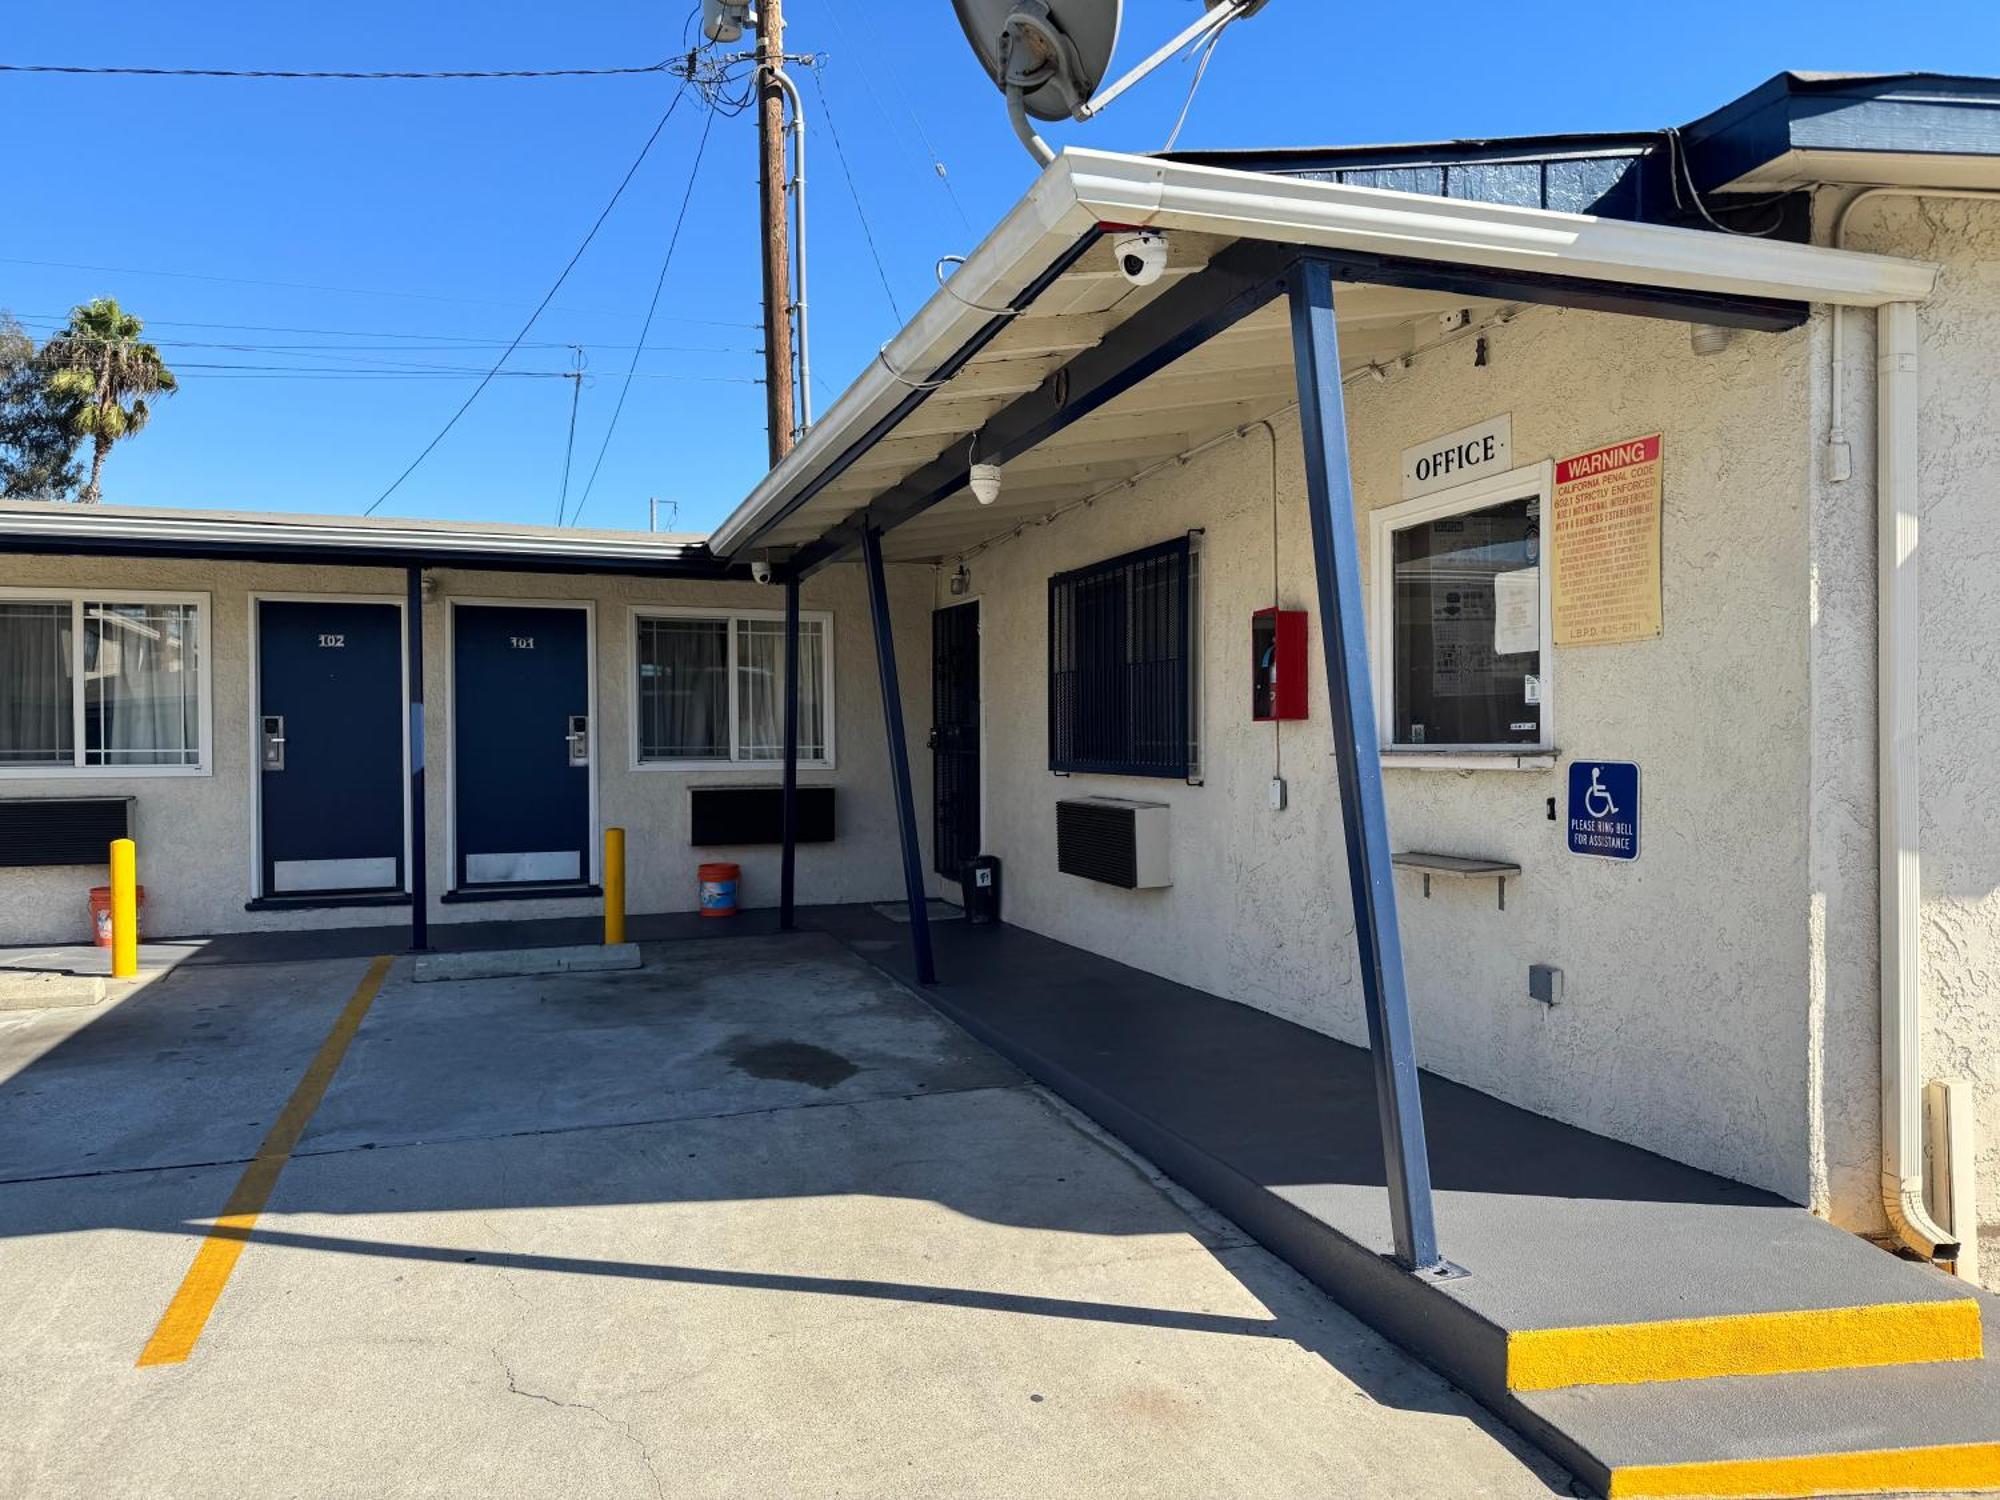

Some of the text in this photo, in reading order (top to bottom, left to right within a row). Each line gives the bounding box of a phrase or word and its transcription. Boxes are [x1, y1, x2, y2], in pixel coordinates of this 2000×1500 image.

[1415, 435, 1495, 481] OFFICE
[1567, 442, 1645, 479] WARNING
[1558, 464, 1655, 496] CALIFORNIA PENAL CODE
[1575, 487, 1609, 504] STRICTLY
[1611, 476, 1656, 496] ENFORCED
[318, 634, 345, 648] 102
[509, 636, 535, 649] 101
[1571, 818, 1633, 836] PLEASE RING BELL
[1574, 833, 1631, 850] FOR ASSISTANCE
